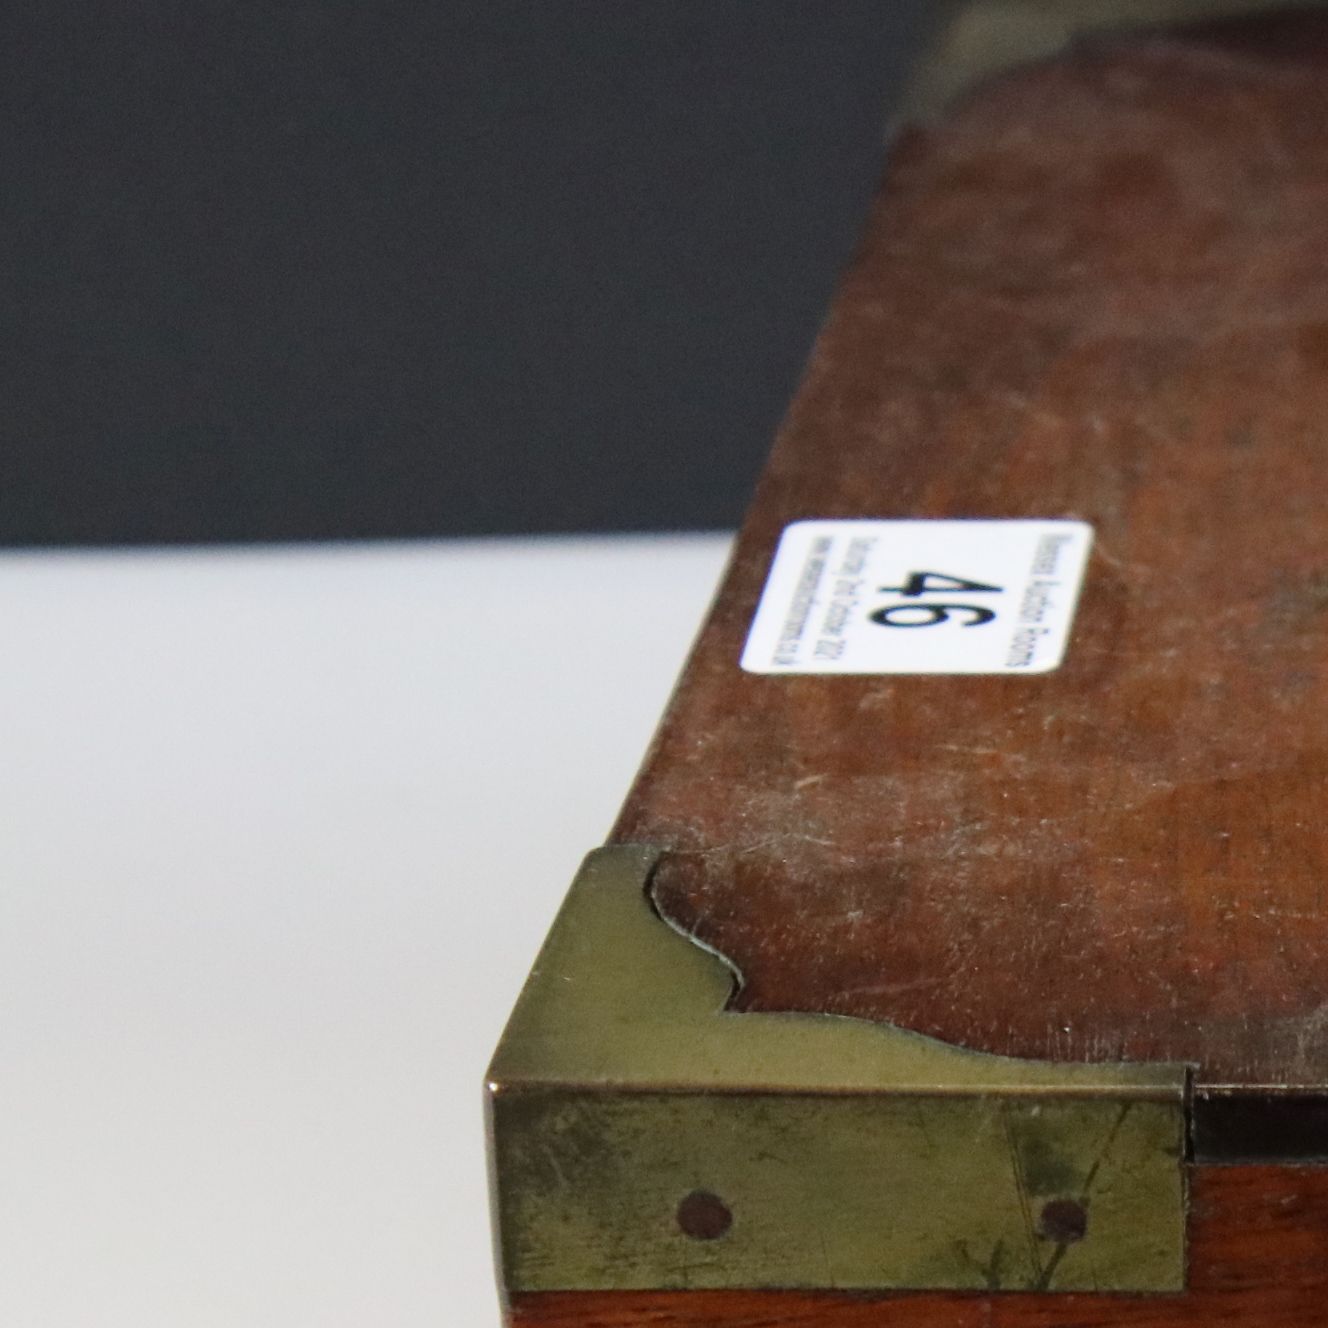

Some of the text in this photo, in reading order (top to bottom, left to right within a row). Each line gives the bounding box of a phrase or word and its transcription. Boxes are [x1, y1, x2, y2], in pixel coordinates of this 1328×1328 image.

[869, 571, 1007, 629] 46
[1018, 580, 1062, 623] Auction
[1005, 627, 1051, 668] Rooms
